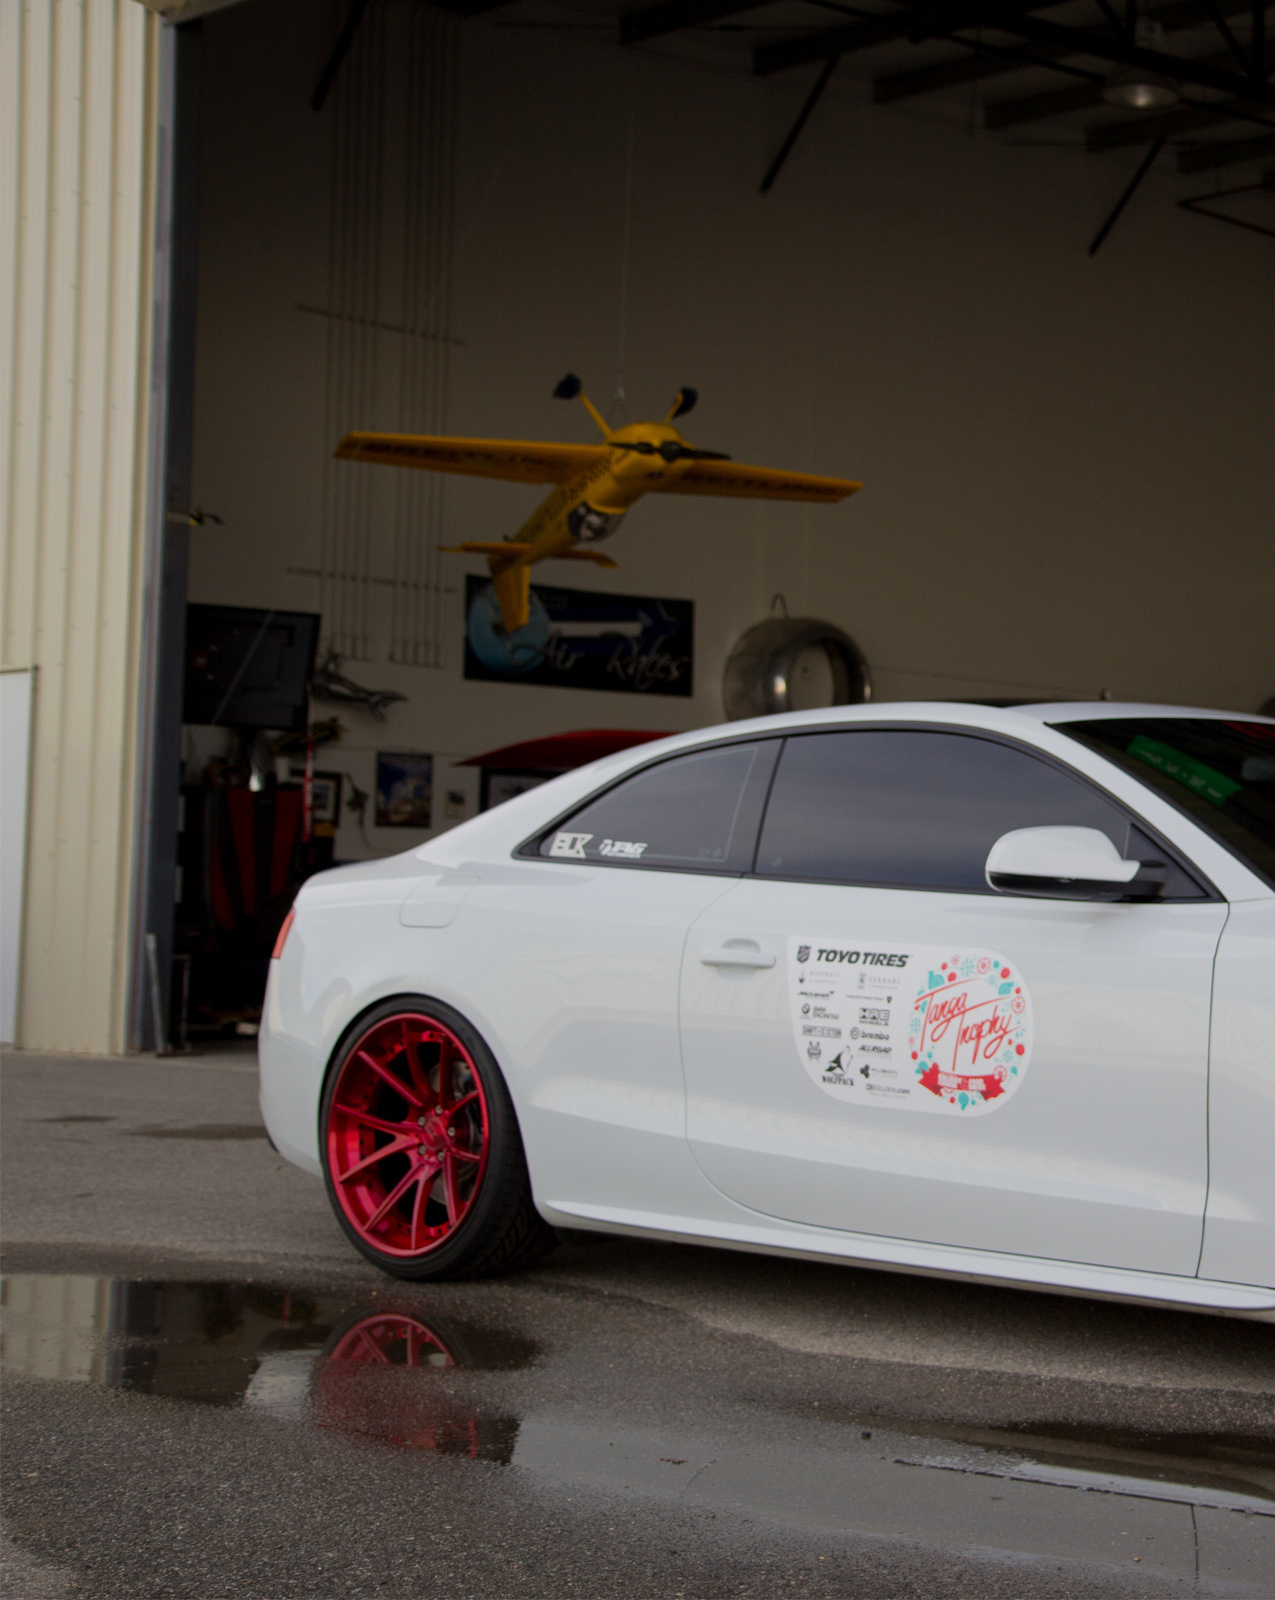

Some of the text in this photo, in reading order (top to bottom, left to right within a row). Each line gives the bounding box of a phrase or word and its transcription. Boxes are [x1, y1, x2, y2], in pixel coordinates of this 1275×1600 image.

[549, 832, 594, 859] BLK
[816, 949, 909, 968] TOYO TIRES
[859, 1007, 890, 1021] HRE
[861, 1030, 889, 1040] brembo
[952, 996, 1024, 1072] Trophy
